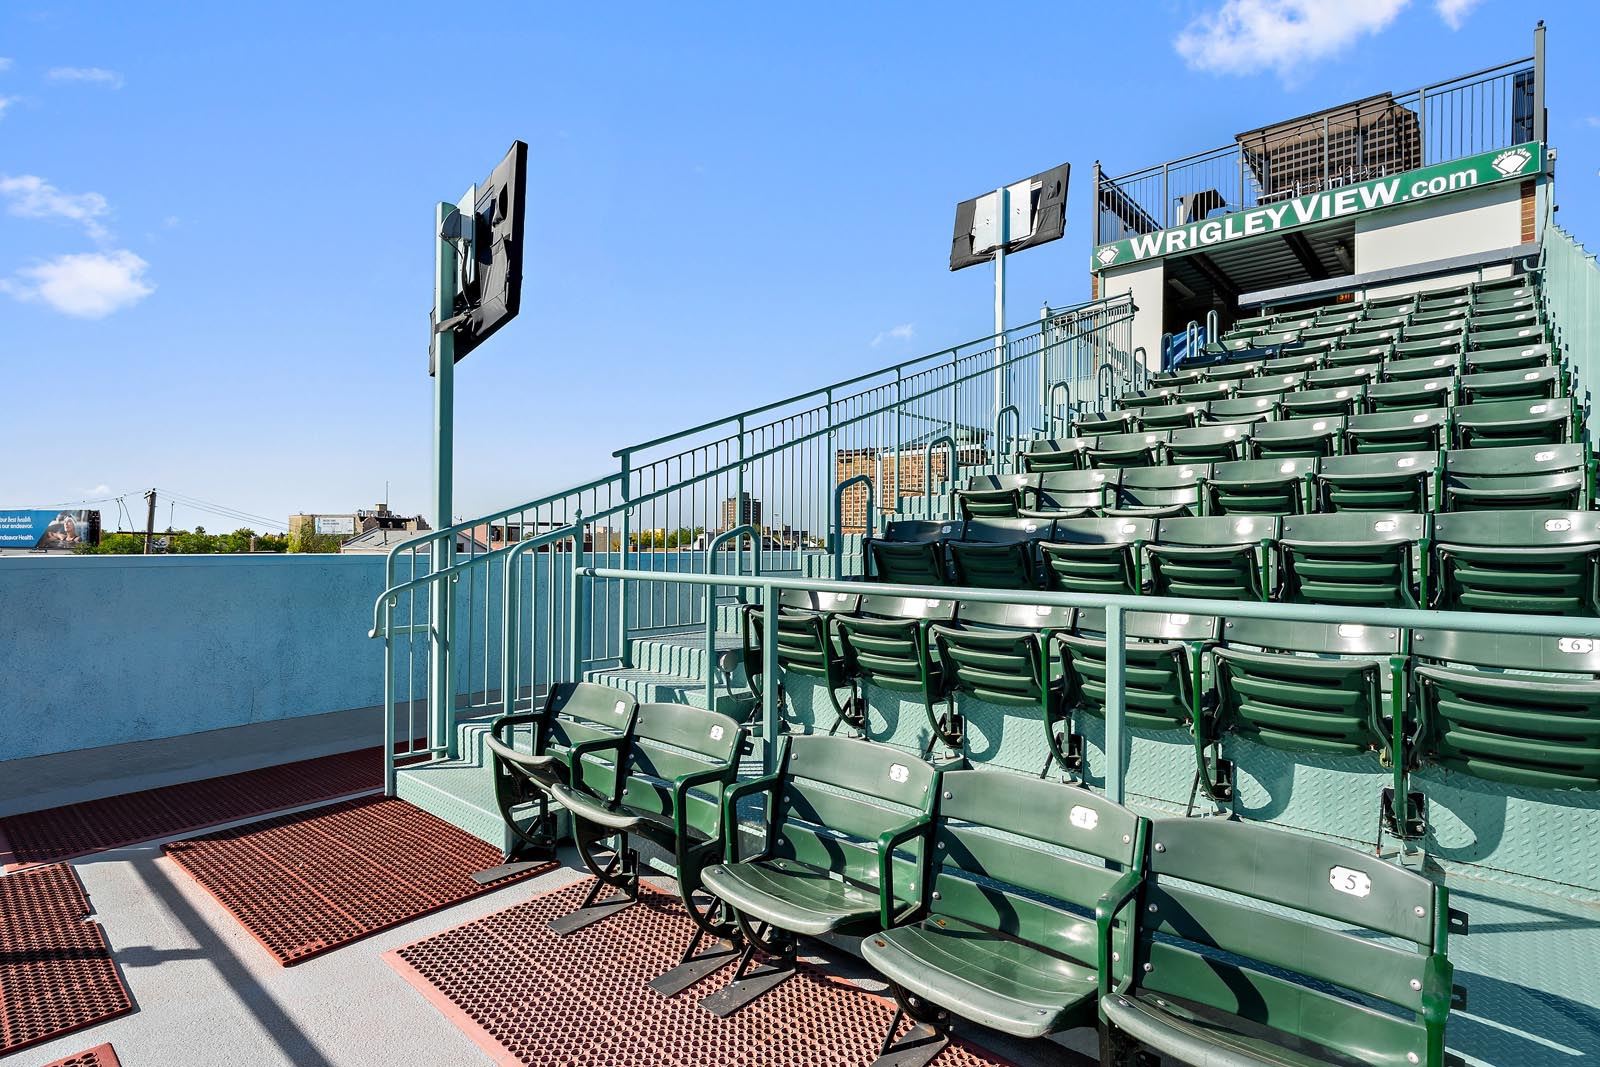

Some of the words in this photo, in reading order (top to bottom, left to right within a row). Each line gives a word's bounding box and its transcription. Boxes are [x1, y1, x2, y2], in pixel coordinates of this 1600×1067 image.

[1571, 640, 1580, 650] 6
[1079, 811, 1088, 825] 4
[1344, 874, 1357, 890] 5
